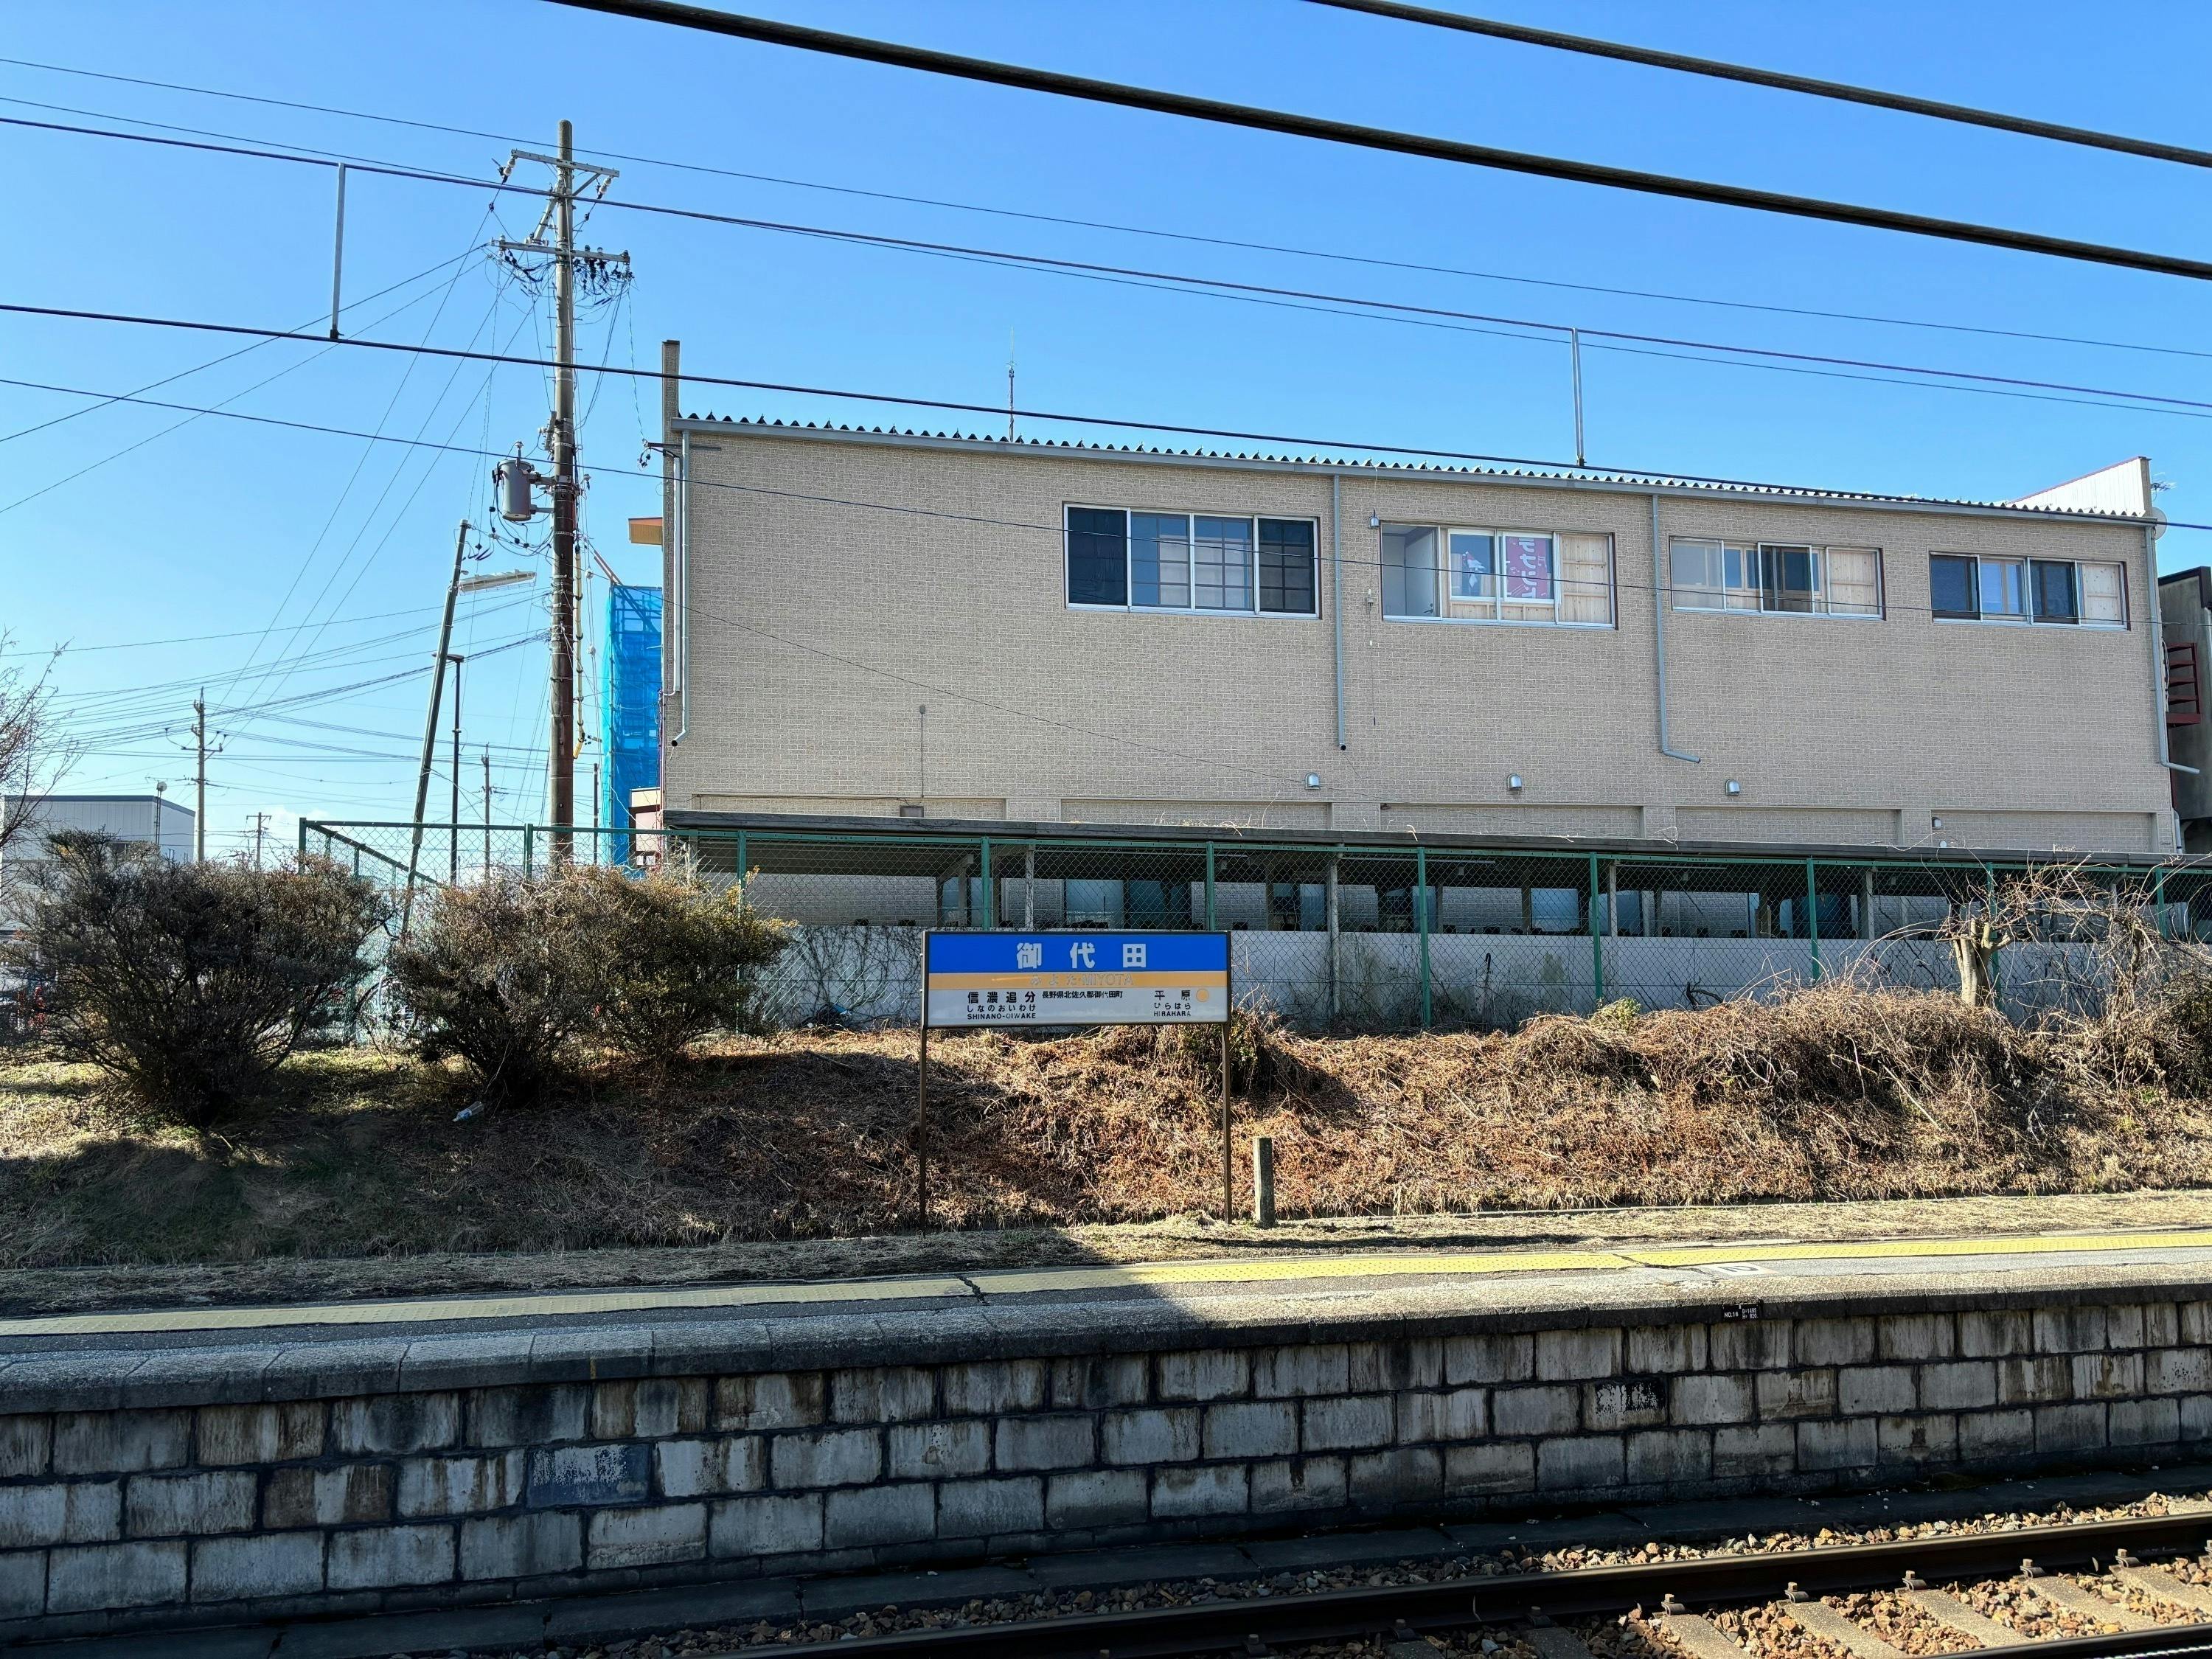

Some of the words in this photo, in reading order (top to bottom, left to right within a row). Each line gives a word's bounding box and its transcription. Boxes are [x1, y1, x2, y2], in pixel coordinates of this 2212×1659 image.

[1016, 942, 1147, 969] 御代田
[1082, 973, 1134, 986] MIYOTA
[967, 991, 1036, 1004] 信濃追分
[1042, 990, 1123, 999] 長野県北佐久郡御代田町
[1154, 990, 1191, 1001] 平原
[967, 1004, 1036, 1012] しなのおいわけ
[1154, 1002, 1191, 1010] ひらはら
